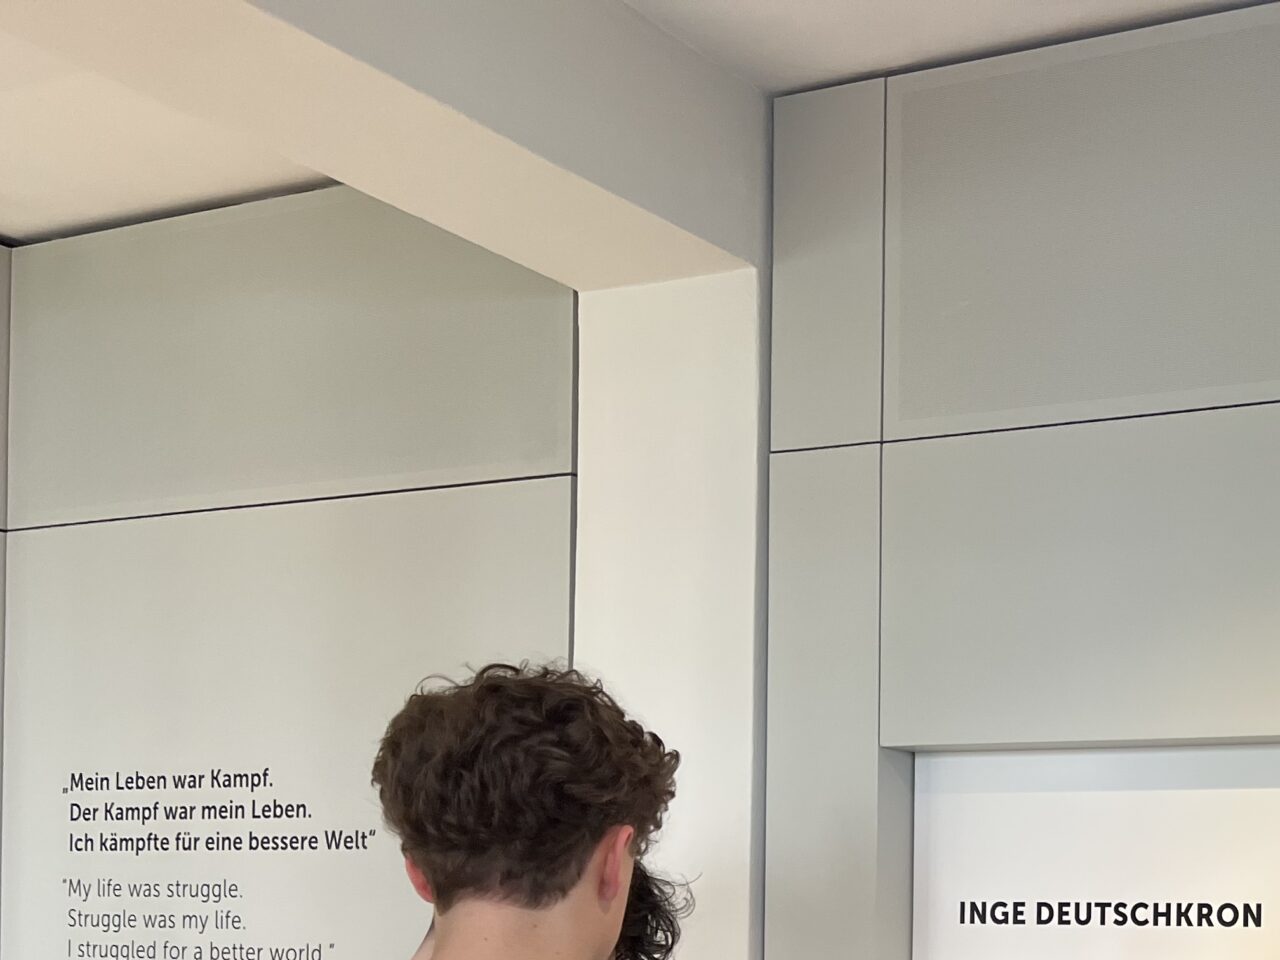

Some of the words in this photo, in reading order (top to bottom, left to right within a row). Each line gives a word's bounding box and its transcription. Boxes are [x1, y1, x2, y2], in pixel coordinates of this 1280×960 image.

[116, 771, 167, 790] Leben
[172, 774, 205, 789] war
[211, 768, 273, 793] Kampf.
[70, 803, 99, 821] Der
[104, 801, 159, 826] Kampf
[163, 805, 196, 820] war
[202, 800, 245, 820] mein
[252, 799, 311, 819] Leben.
[70, 833, 94, 852] Ich
[100, 832, 170, 856] kämpfte
[175, 832, 200, 851] für
[205, 831, 243, 851] eine
[249, 831, 318, 851] bessere
[97, 878, 122, 897] life
[128, 881, 160, 898] was
[167, 879, 243, 903] struggle.
[68, 909, 137, 933] Struggle
[142, 914, 176, 929] was
[182, 914, 209, 934] my
[215, 910, 246, 930] life.
[960, 901, 1026, 925] INGE
[1036, 902, 1262, 927] DEUTSCHKRON
[67, 939, 72, 957] I
[163, 940, 188, 960] for
[194, 946, 202, 960] a
